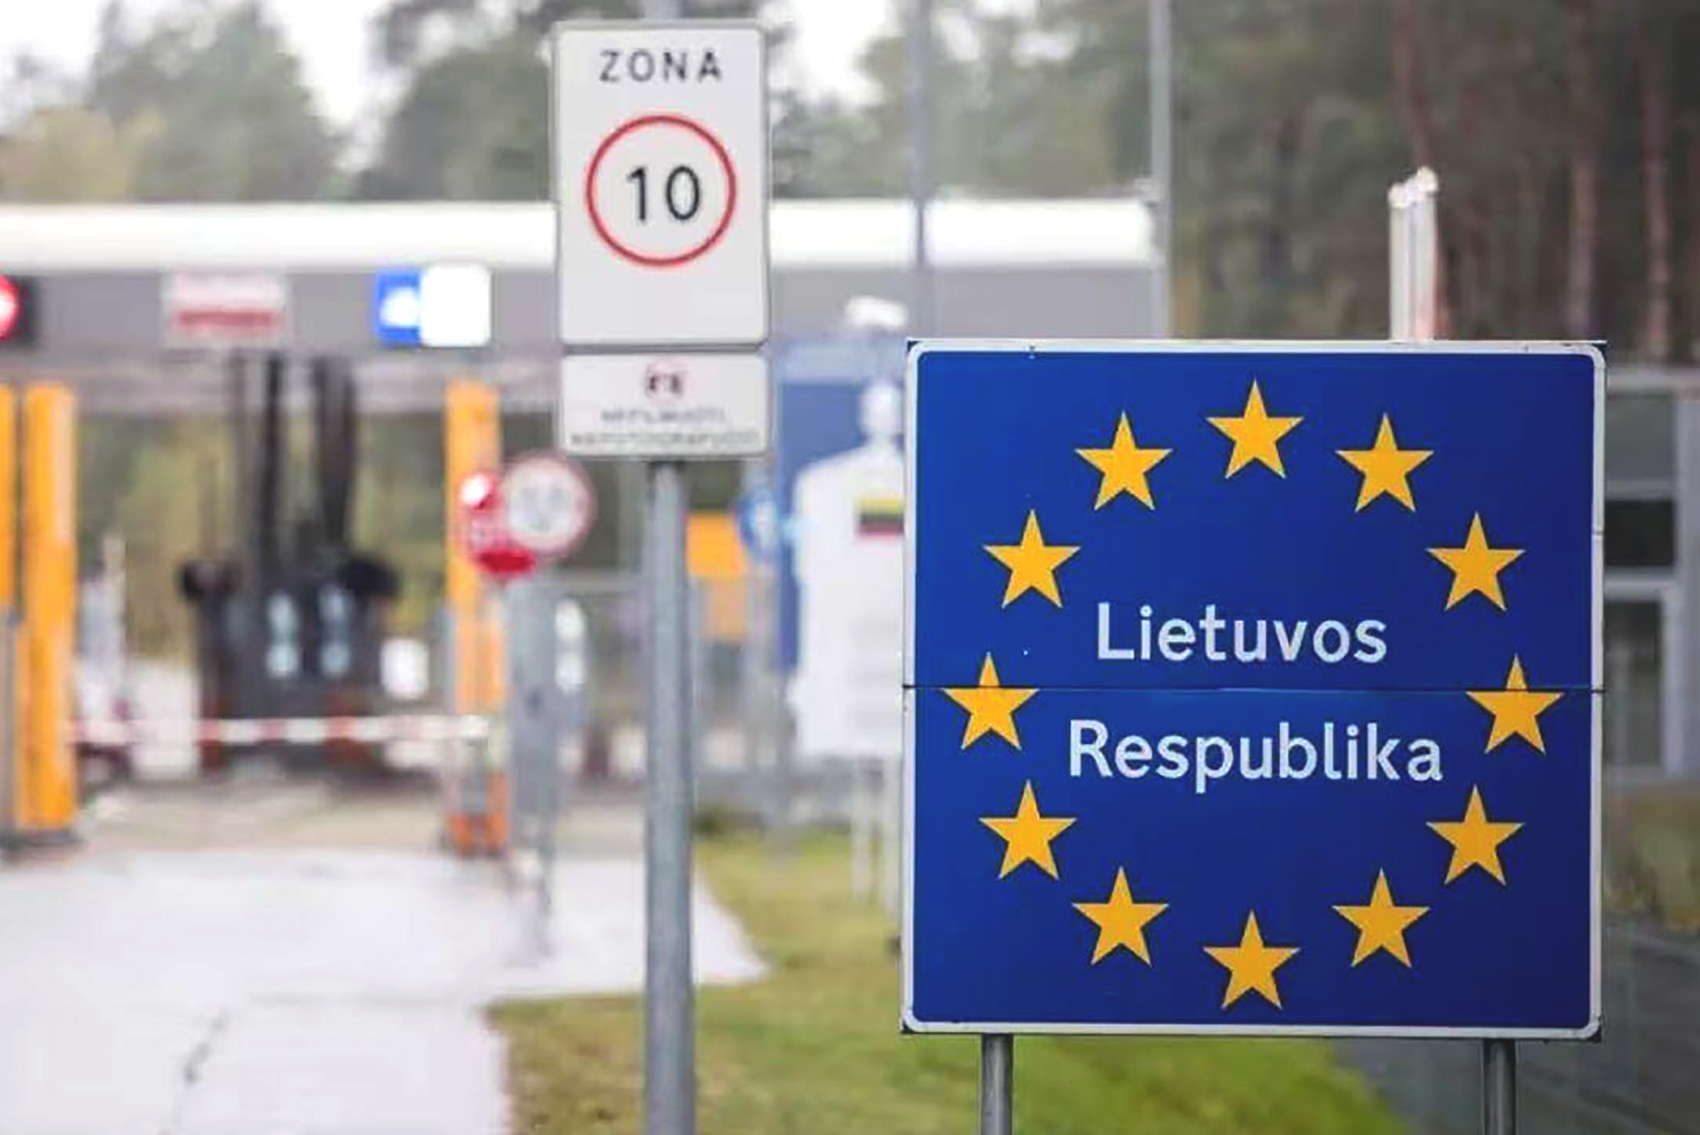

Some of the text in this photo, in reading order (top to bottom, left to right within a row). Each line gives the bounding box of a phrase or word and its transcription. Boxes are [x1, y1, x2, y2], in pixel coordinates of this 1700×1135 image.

[600, 50, 721, 82] ZONA
[626, 165, 702, 223] 10
[1098, 602, 1387, 663] Lietuvos
[1070, 719, 1443, 794] Respublika
